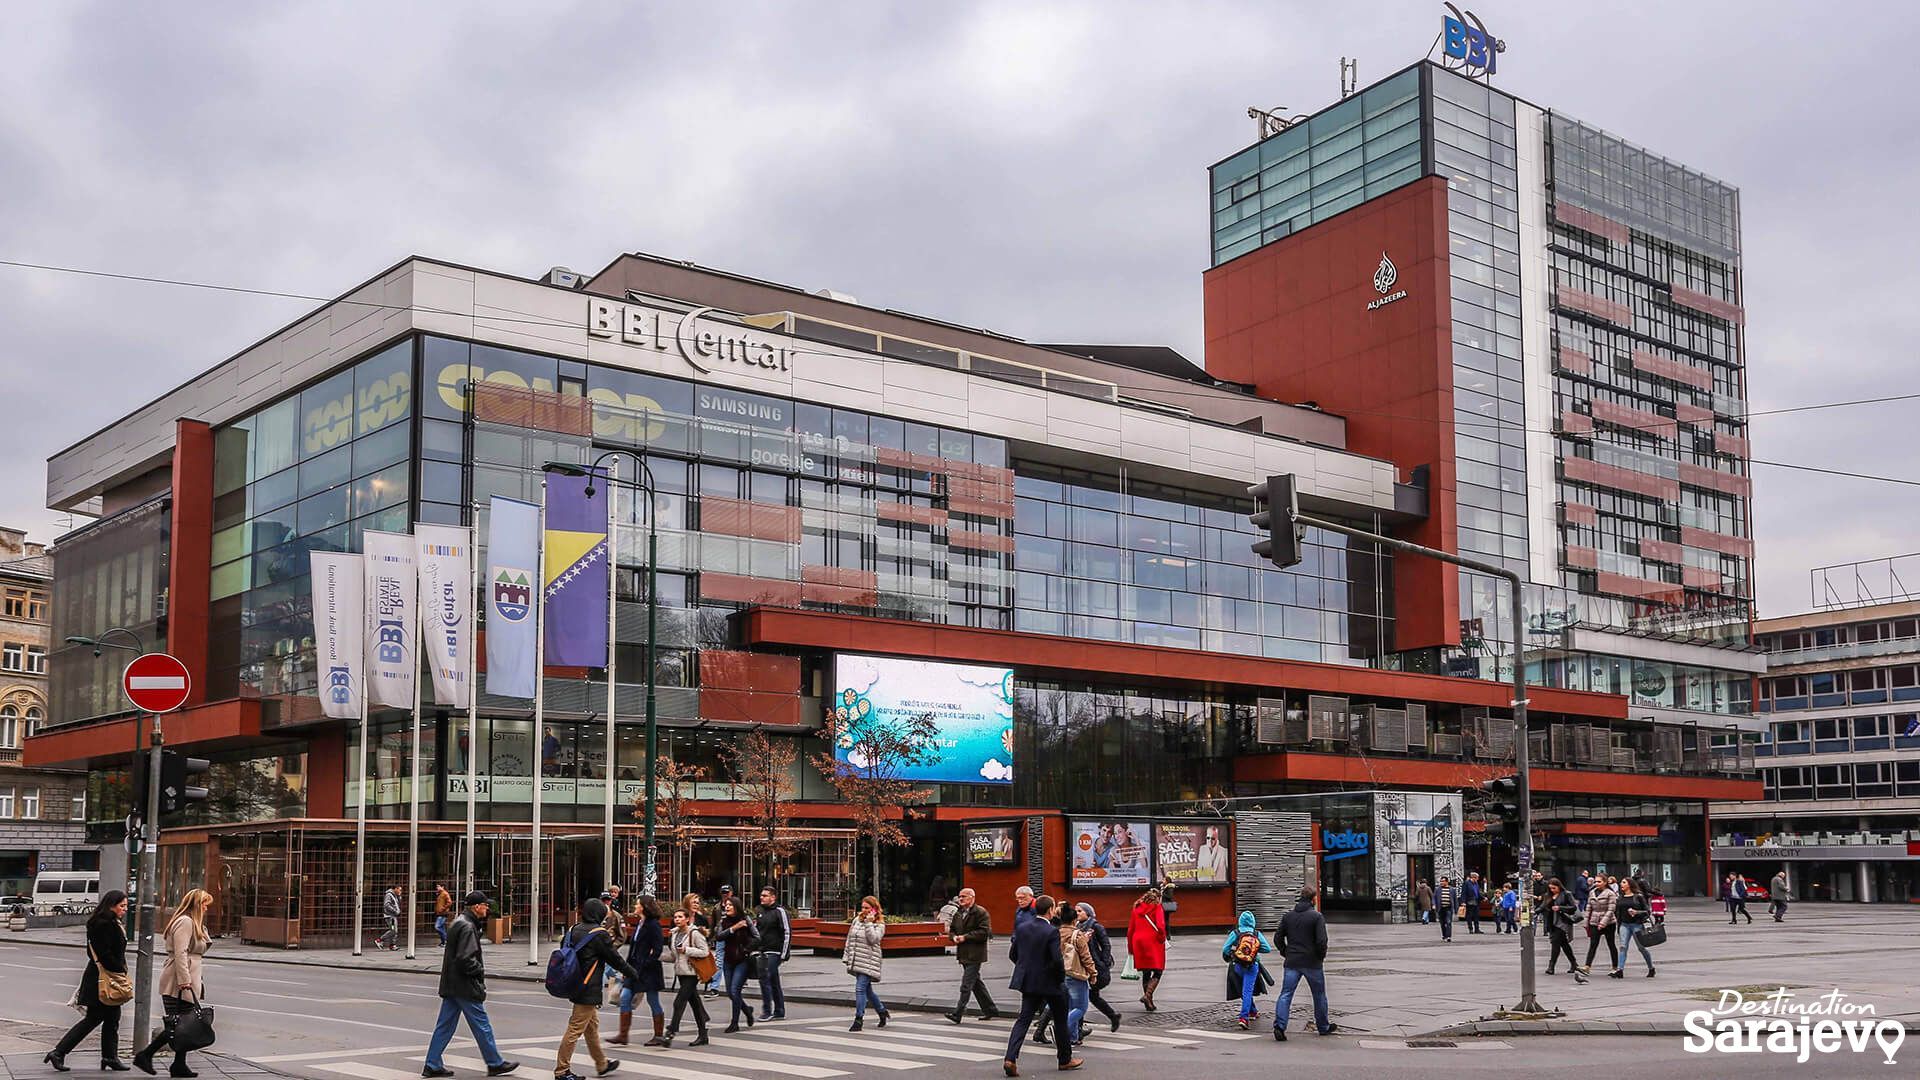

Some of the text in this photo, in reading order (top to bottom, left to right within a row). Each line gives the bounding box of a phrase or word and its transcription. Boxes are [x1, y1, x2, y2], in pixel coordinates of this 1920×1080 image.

[1441, 15, 1496, 76] BBI
[588, 299, 668, 350] BBI
[700, 394, 782, 422] SAMSUNG
[927, 438, 969, 456] acer
[751, 448, 815, 471] gorenje
[1380, 809, 1399, 820] FUN
[1158, 839, 1190, 854] SAŠA
[1323, 829, 1369, 849] beko
[1434, 827, 1443, 851] JOY
[1744, 849, 1800, 857] CINEMA CITY
